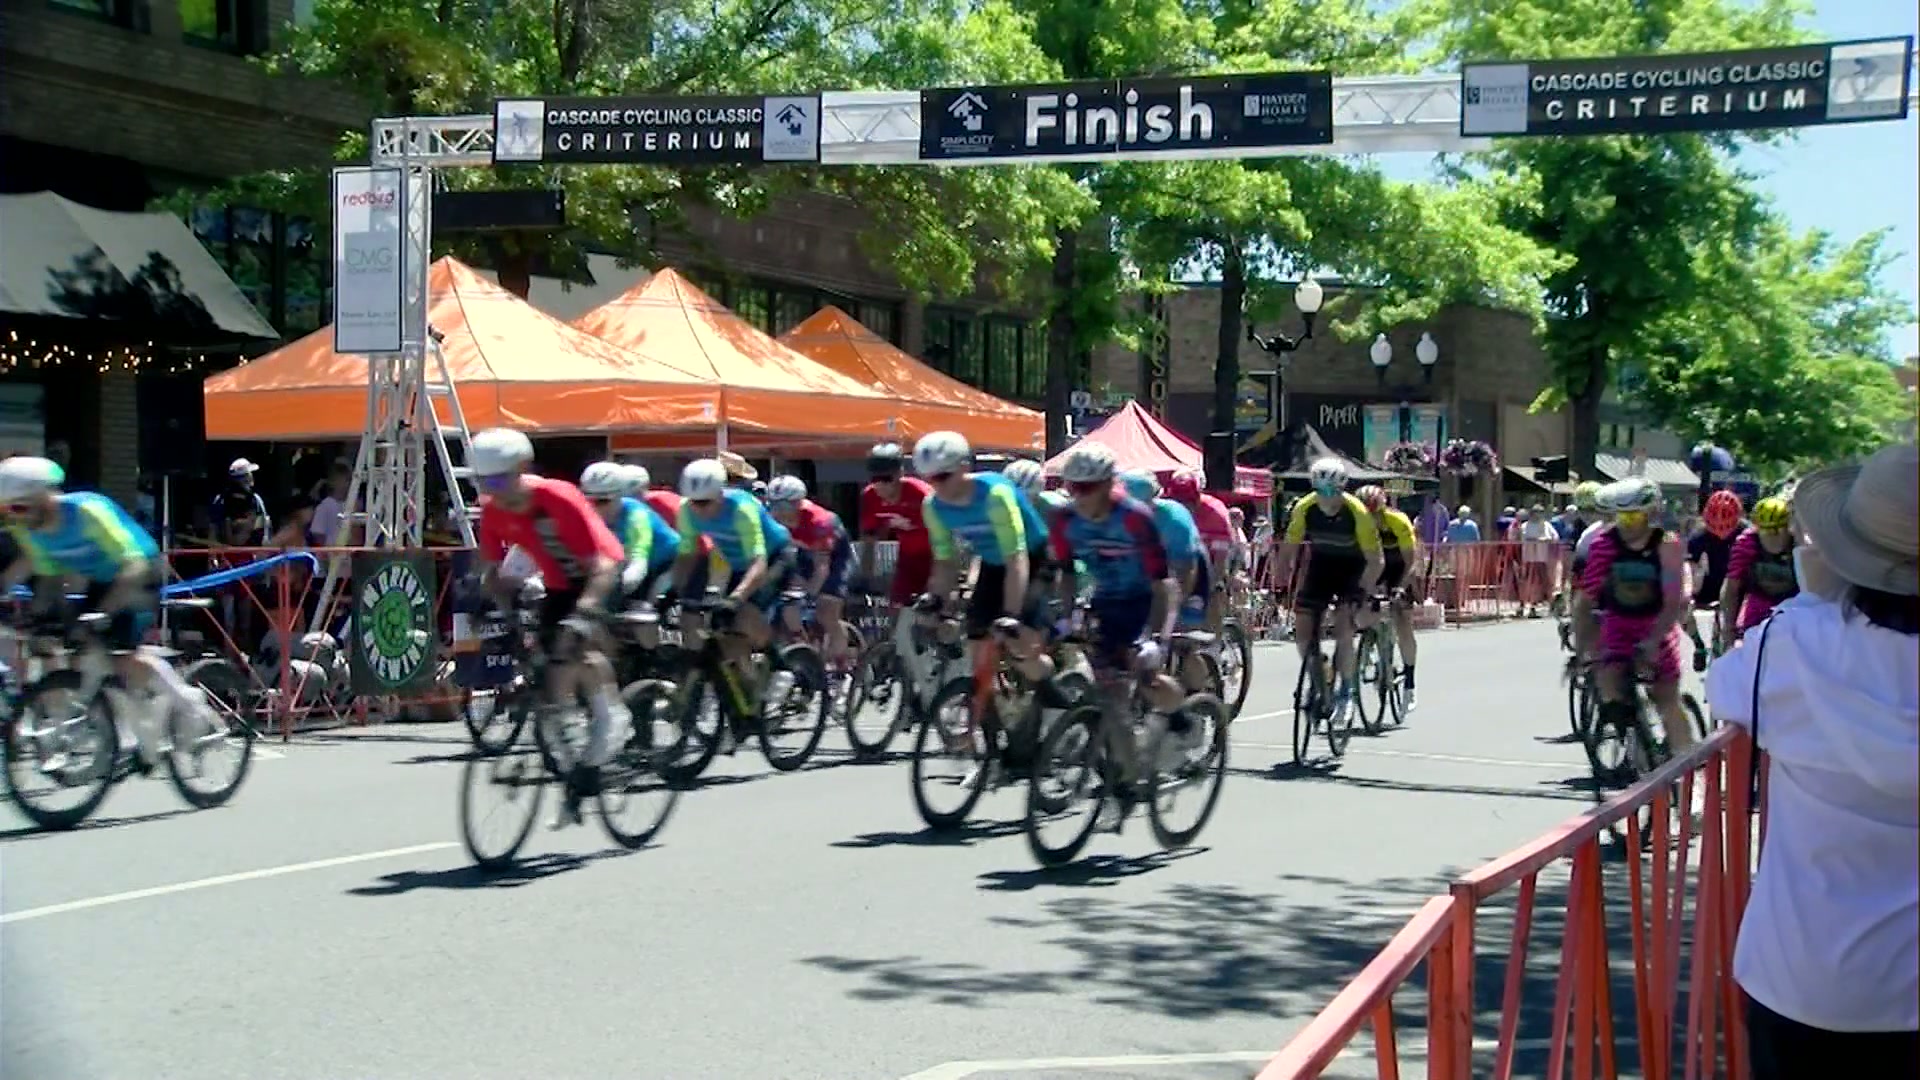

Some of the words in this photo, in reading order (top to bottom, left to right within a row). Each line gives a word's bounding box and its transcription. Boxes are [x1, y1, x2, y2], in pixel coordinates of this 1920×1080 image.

[1532, 72, 1627, 93] CASCADE
[1632, 66, 1724, 89] CYCLING
[1728, 59, 1825, 83] CLASSIC
[547, 109, 620, 126] CASCADE
[623, 109, 692, 125] CYCLING
[696, 107, 763, 124] CLASSIC
[1025, 85, 1214, 147] Finish
[1545, 88, 1806, 120] CRITERIUM
[557, 131, 751, 151] CRITERIUM
[345, 247, 393, 266] CMG
[1319, 404, 1359, 429] PAPER
[363, 565, 426, 608] WORTHY
